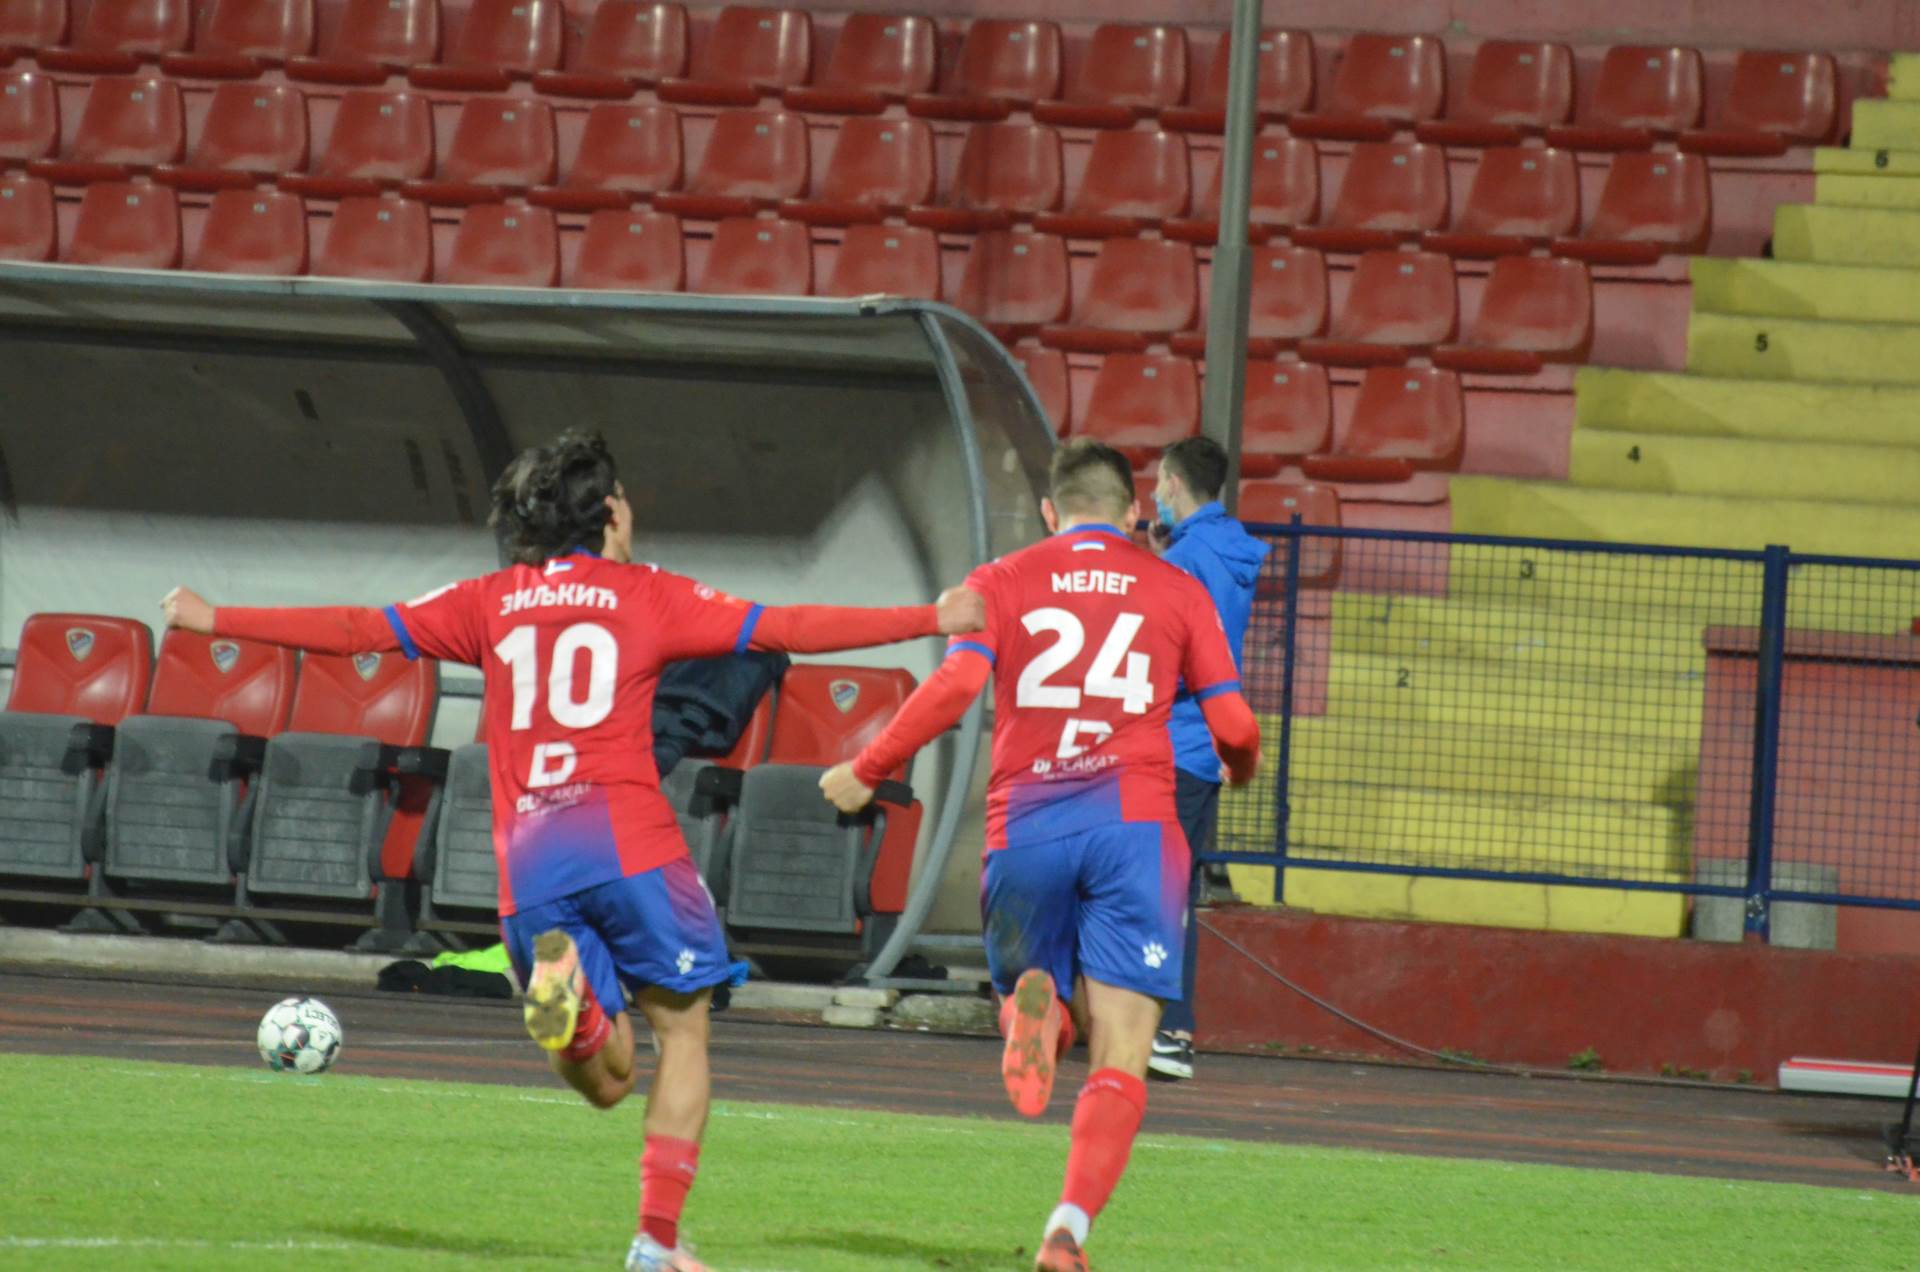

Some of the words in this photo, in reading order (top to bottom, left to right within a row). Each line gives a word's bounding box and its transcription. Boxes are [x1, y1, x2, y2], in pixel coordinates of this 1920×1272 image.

[1875, 149, 1889, 169] 6
[1755, 333, 1768, 352] 5
[1627, 445, 1640, 464] 4
[1520, 559, 1533, 579] 3
[1051, 570, 1137, 595] МЕЛЕГ
[500, 583, 618, 616] ЗИЉКИЋ
[1016, 607, 1154, 714] 24
[494, 622, 618, 731] 10
[1396, 668, 1409, 688] 2
